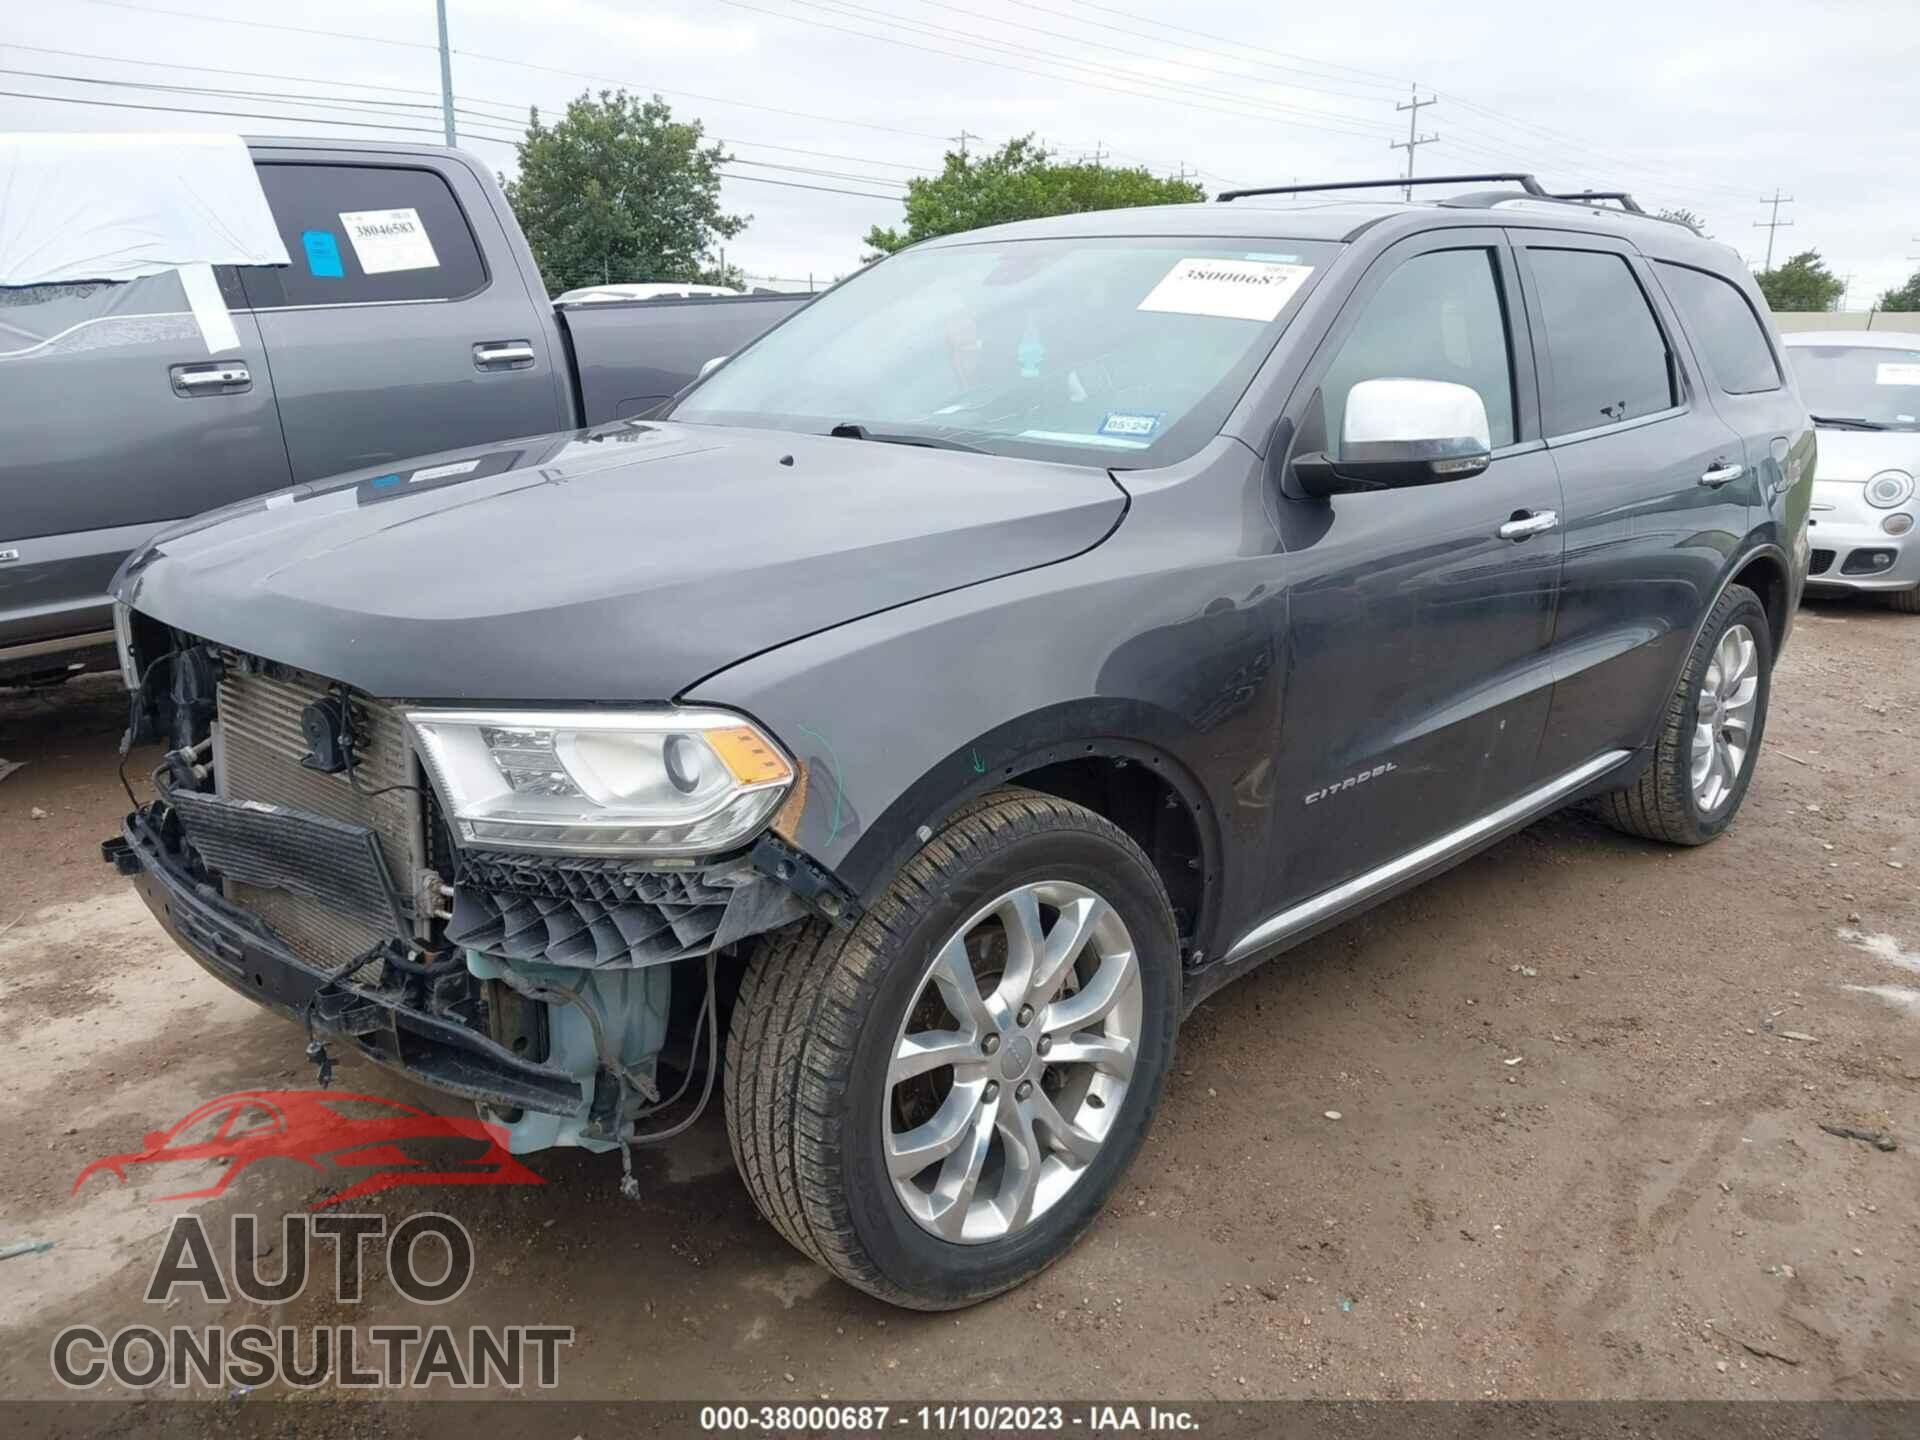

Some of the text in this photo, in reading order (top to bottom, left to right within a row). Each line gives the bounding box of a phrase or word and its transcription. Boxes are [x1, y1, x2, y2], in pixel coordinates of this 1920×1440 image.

[355, 221, 416, 238] 38046583
[1178, 269, 1288, 287] 38000687
[1305, 762, 1398, 805] CITADEL
